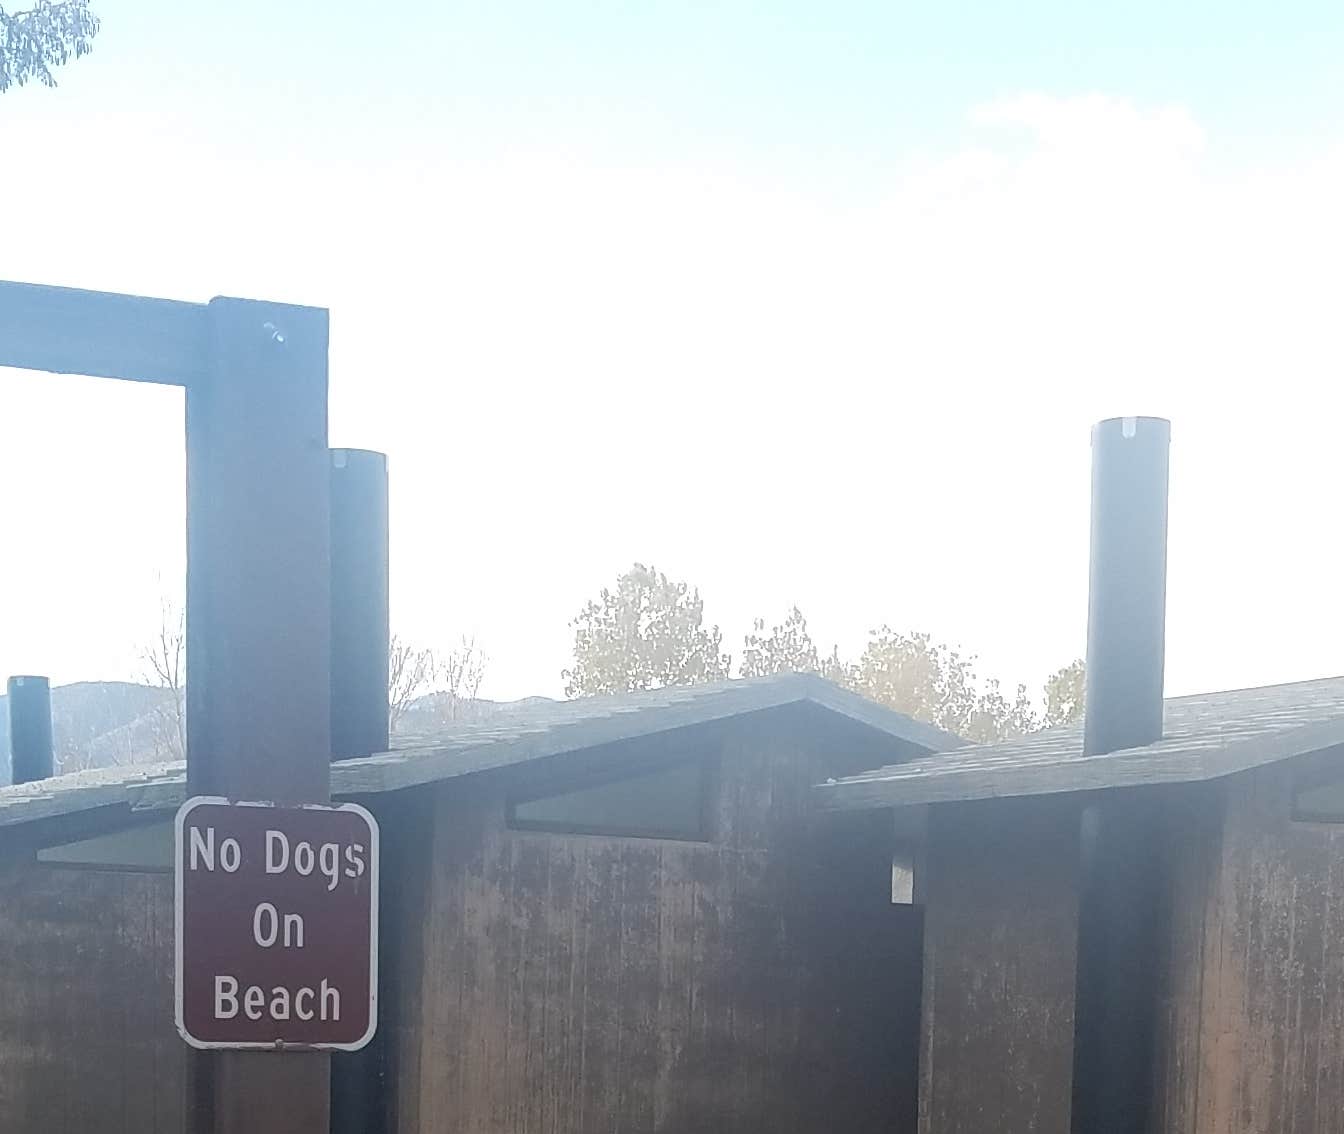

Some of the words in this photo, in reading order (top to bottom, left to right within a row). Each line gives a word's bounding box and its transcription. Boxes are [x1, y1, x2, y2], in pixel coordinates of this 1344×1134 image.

[189, 826, 241, 873] No
[265, 830, 365, 891] Dogs
[253, 902, 304, 948] On
[214, 975, 340, 1021] Beach
